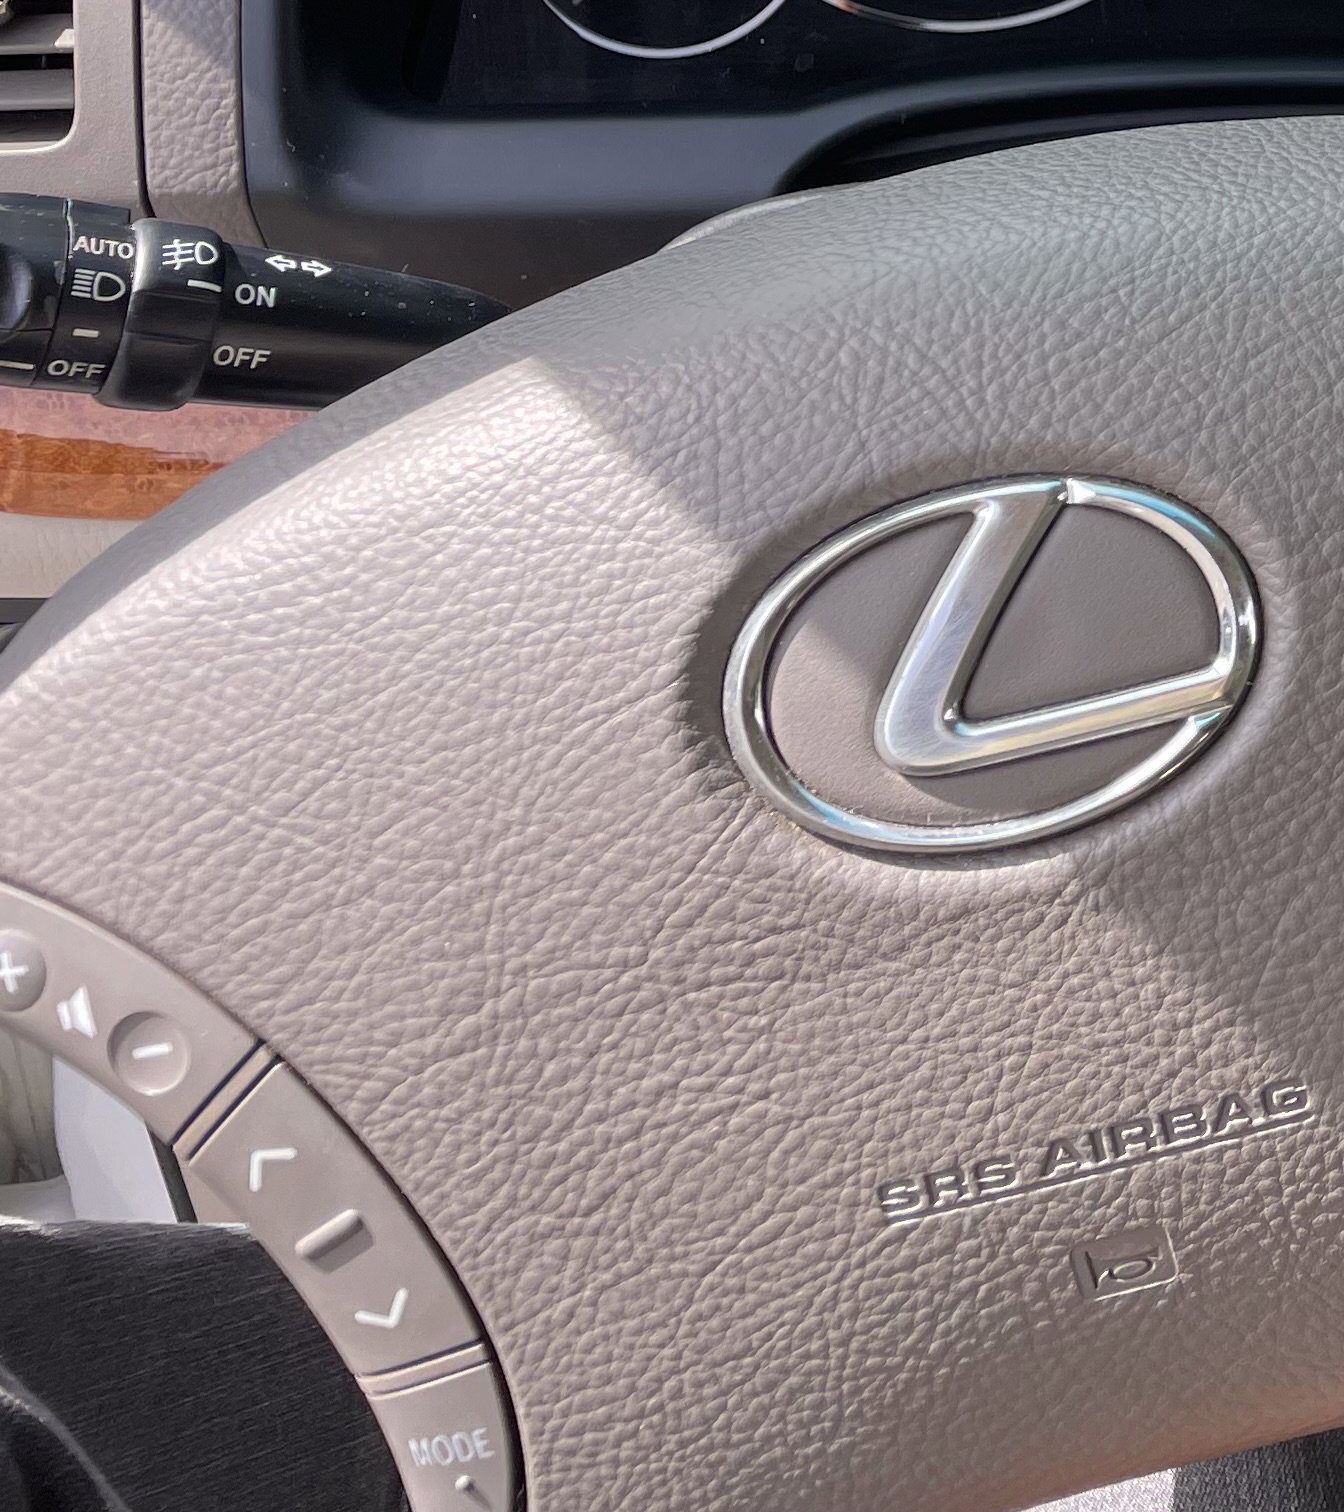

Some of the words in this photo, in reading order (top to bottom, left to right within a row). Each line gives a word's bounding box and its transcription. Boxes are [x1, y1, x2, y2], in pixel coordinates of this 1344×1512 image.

[72, 234, 134, 261] AUTO
[234, 283, 277, 309] ON
[46, 359, 106, 380] OFF
[212, 344, 272, 370] OFF
[877, 1153, 1020, 1219] SRS
[1038, 1083, 1314, 1180] AIRBAG
[408, 1425, 495, 1467] MODE
